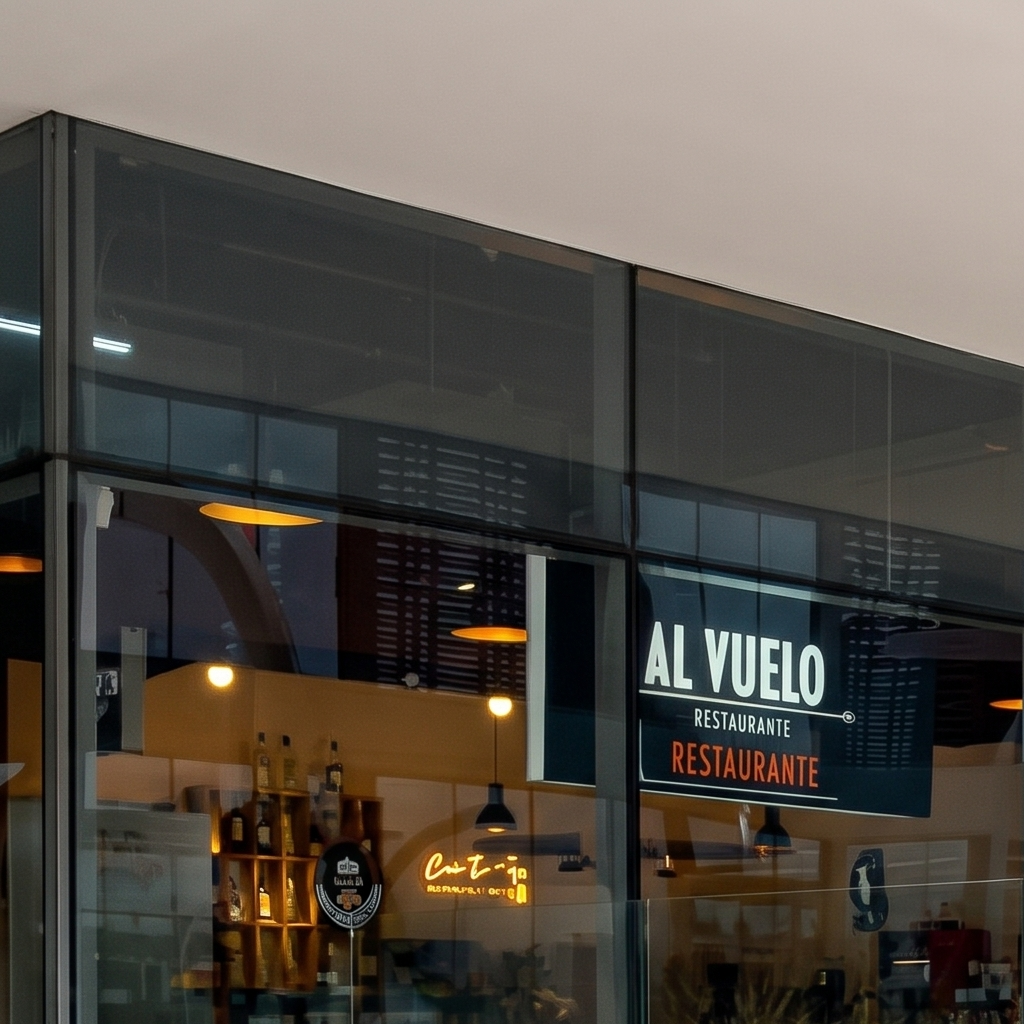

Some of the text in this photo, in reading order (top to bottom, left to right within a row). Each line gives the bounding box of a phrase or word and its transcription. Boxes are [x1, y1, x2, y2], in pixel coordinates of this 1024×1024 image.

[644, 621, 825, 707] AL VUELO
[694, 708, 791, 738] RESTAURANTE
[672, 740, 819, 788] RESTAURANTE
